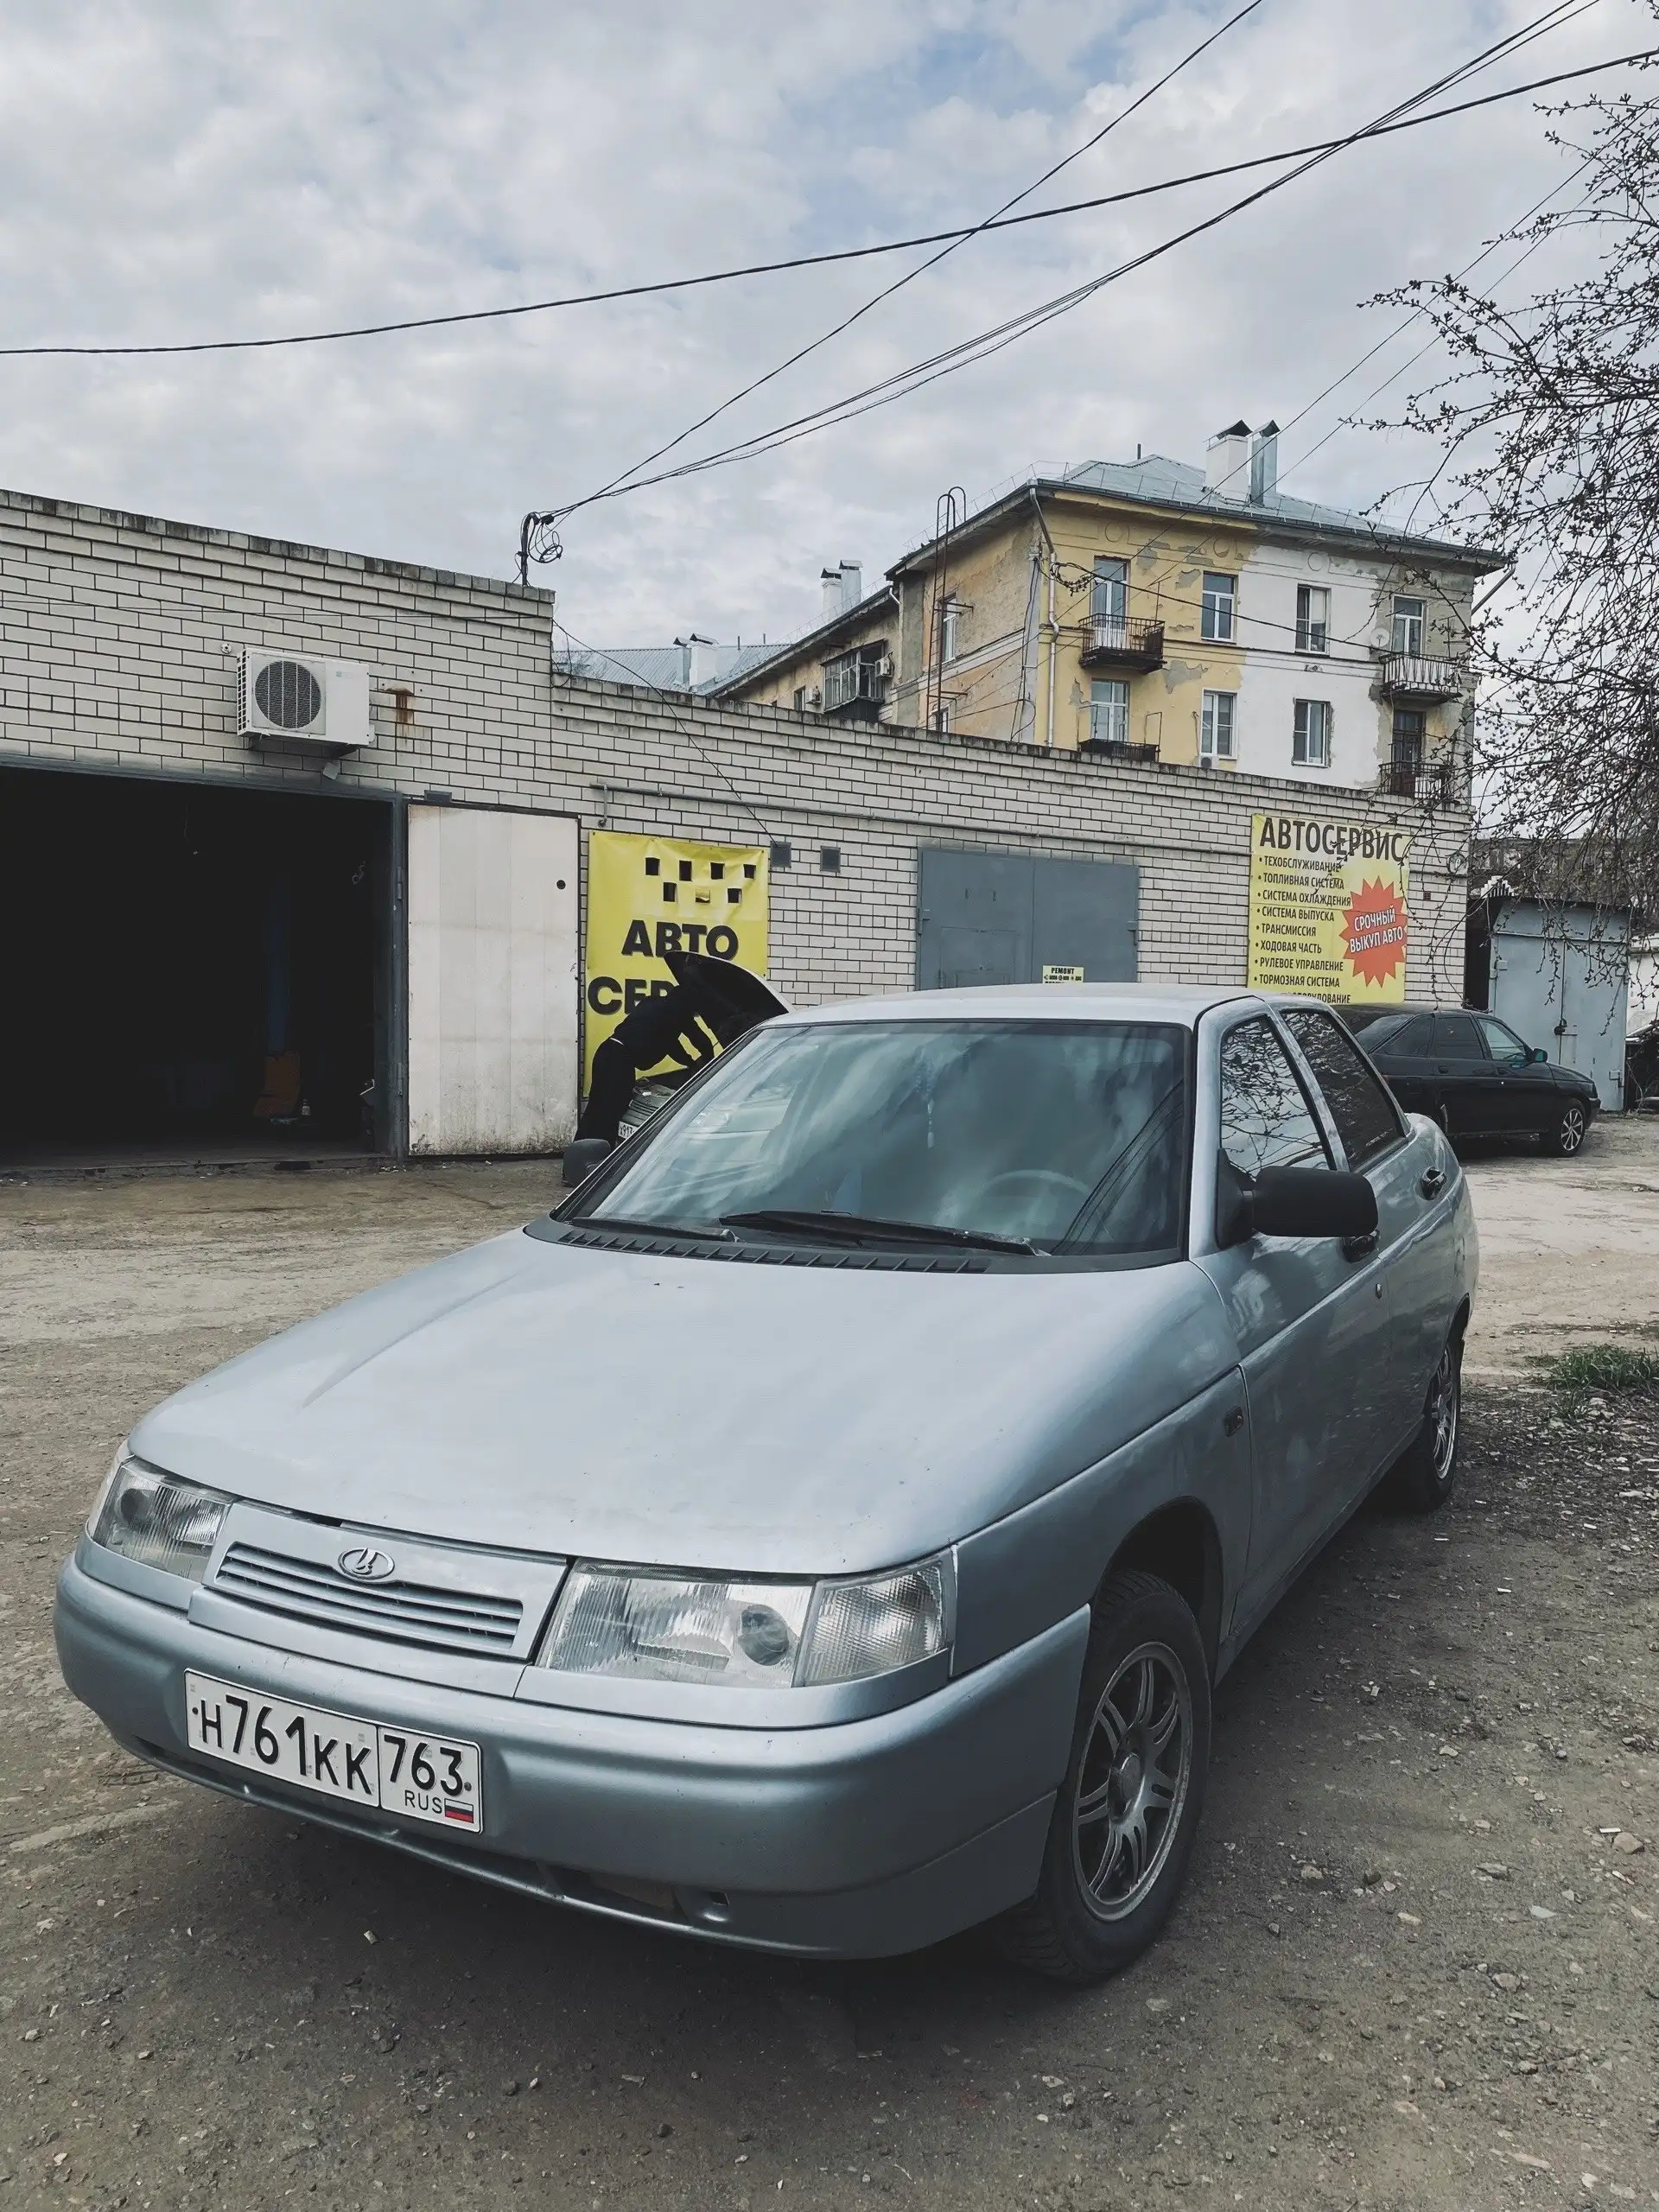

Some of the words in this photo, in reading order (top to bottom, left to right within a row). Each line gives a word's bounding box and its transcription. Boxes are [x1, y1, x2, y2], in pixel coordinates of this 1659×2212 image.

[1259, 817, 1403, 862] АВТОСЕРВИС
[1264, 855, 1340, 873] ТЕХОБСЛУЖИВАНИЕ
[1263, 873, 1309, 887] ТОПЛИВНАЯ
[1311, 877, 1344, 889] СИСТЕМА
[1262, 889, 1297, 902] СИСТЕМА
[1299, 893, 1351, 906] ОХЛАЖДЕНИЯ
[1262, 906, 1296, 919] СИСТЕМА
[1299, 909, 1335, 922] ВЫПУСКА
[1354, 905, 1396, 931] СРОЧНЫЙ
[1262, 923, 1316, 937] ТРАНСМИССИЯ
[621, 919, 739, 961] АВТО
[1261, 940, 1296, 953] ХОДОВАЯ
[1299, 943, 1322, 954] ЧАСТЬ
[1350, 931, 1381, 953] ВЫКУП
[1382, 926, 1403, 945] АВТО
[1260, 957, 1294, 969] РУЛЕВОЕ
[1295, 959, 1344, 971] УПРАВЛЕНИЕ
[1259, 974, 1305, 986] ТОРМОЗНАЯ
[1306, 976, 1340, 988] СИСТЕМА
[588, 976, 680, 1016] СЕР
[384, 1734, 464, 1797] 763
[404, 1789, 442, 1815] RUS
